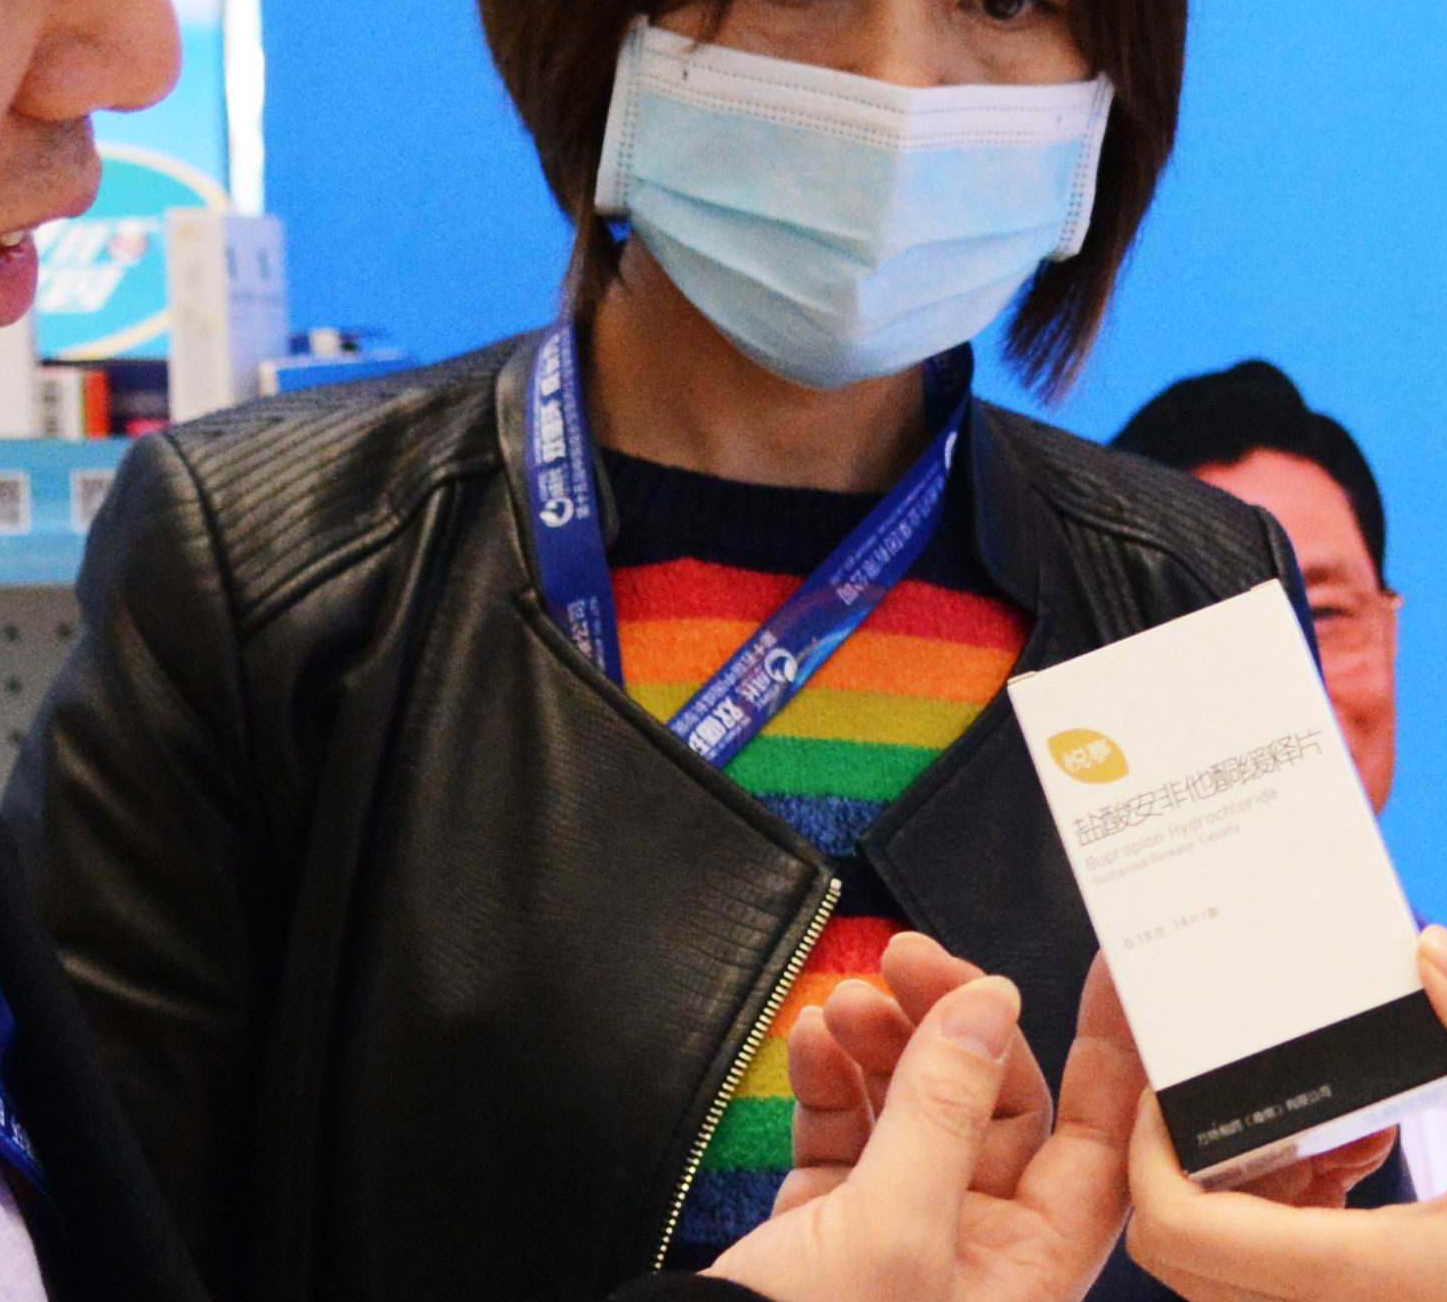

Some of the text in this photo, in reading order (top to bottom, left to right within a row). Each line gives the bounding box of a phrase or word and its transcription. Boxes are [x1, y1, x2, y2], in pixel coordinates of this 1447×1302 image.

[1073, 728, 1322, 846] 盐酸安非他酮缓释片
